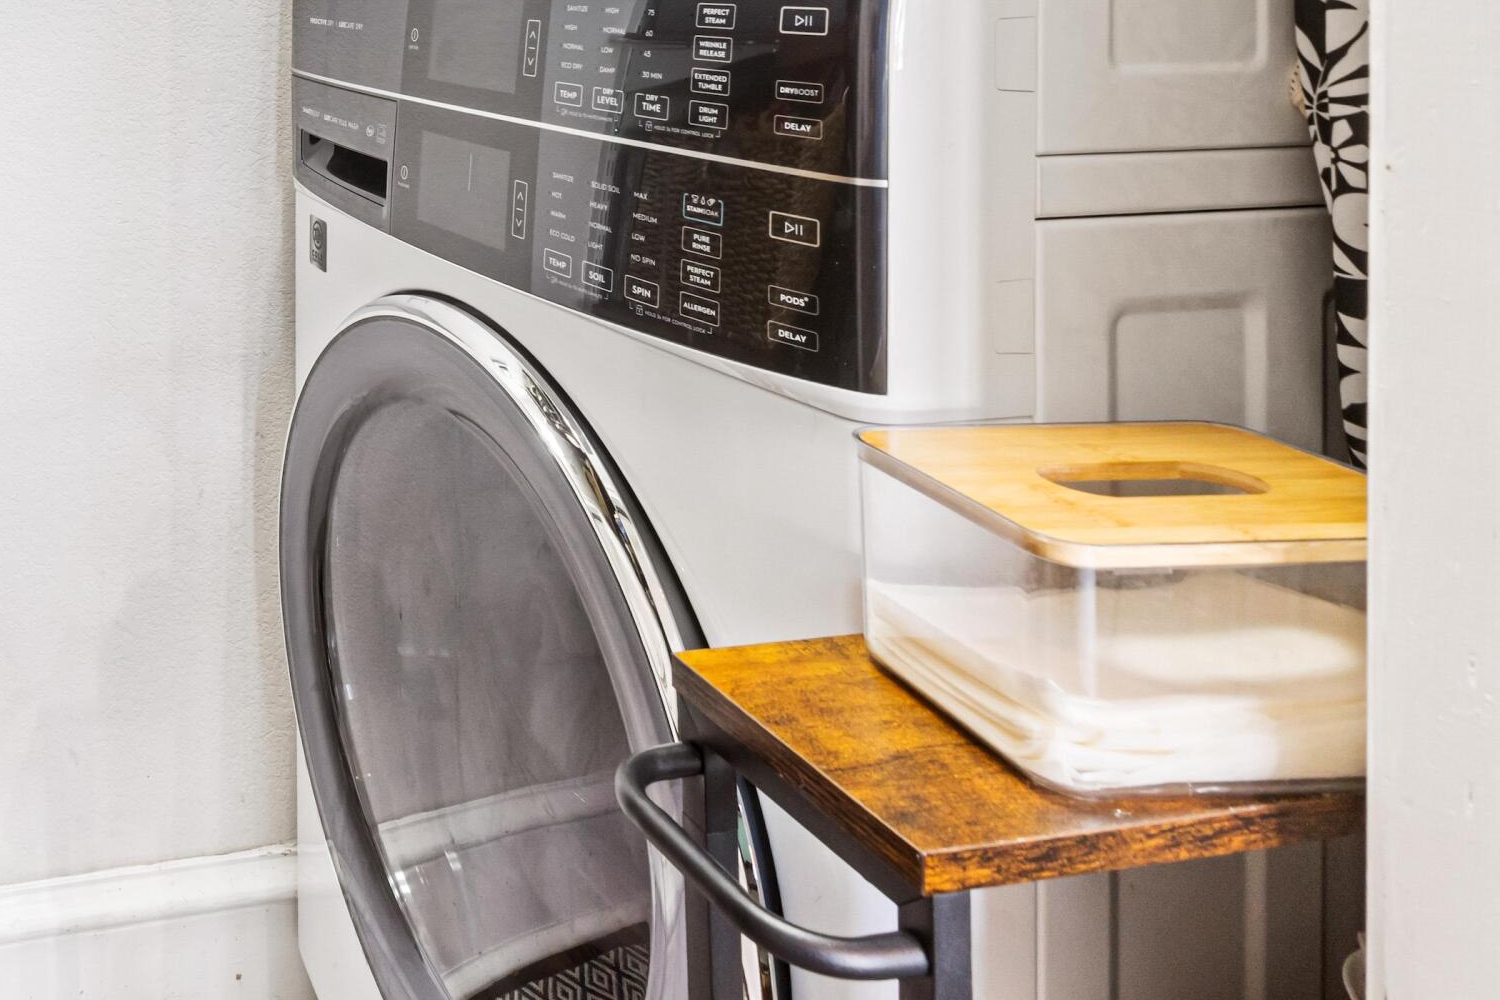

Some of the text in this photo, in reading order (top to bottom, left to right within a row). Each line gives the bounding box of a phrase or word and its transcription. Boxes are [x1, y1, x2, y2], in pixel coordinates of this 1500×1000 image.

[566, 4, 588, 12] SANITIZE
[702, 7, 730, 16] PERFECT
[704, 16, 726, 25] STEAM
[602, 27, 626, 35] NORMAL
[699, 40, 727, 49] WRINKLE
[601, 46, 614, 54] LOW
[643, 50, 652, 58] 45
[699, 48, 726, 58] RELEASE
[599, 66, 615, 74] DAMP
[694, 72, 728, 83] EXTENDED
[602, 87, 614, 95] DRY
[698, 81, 722, 92] TUMBLE
[779, 86, 819, 96] DRYBOOST
[559, 89, 578, 99] TEMP
[645, 93, 659, 102] DRY
[596, 95, 619, 107] LEVEL
[642, 102, 661, 113] TIME
[698, 105, 719, 115] DRUM
[698, 114, 718, 124] LIGHT
[784, 121, 812, 133] DELAY
[607, 184, 620, 194] SOIL
[633, 191, 648, 200] MAX
[589, 201, 608, 211] HEAVY
[632, 212, 658, 224] MEDIUM
[588, 221, 612, 234] NORMAL
[631, 233, 646, 242] LOW
[693, 233, 711, 244] PURE
[587, 241, 603, 251] LIGHT
[692, 242, 711, 252] RINSE
[548, 257, 567, 269] TEMP
[630, 253, 656, 267] NO SPIN
[588, 270, 606, 283] SOIL
[686, 265, 714, 279] PERFECT
[689, 274, 711, 286] STEAM
[631, 285, 652, 298] SPIN
[683, 301, 716, 316] ALLERGEN
[778, 328, 807, 343] DELAY
